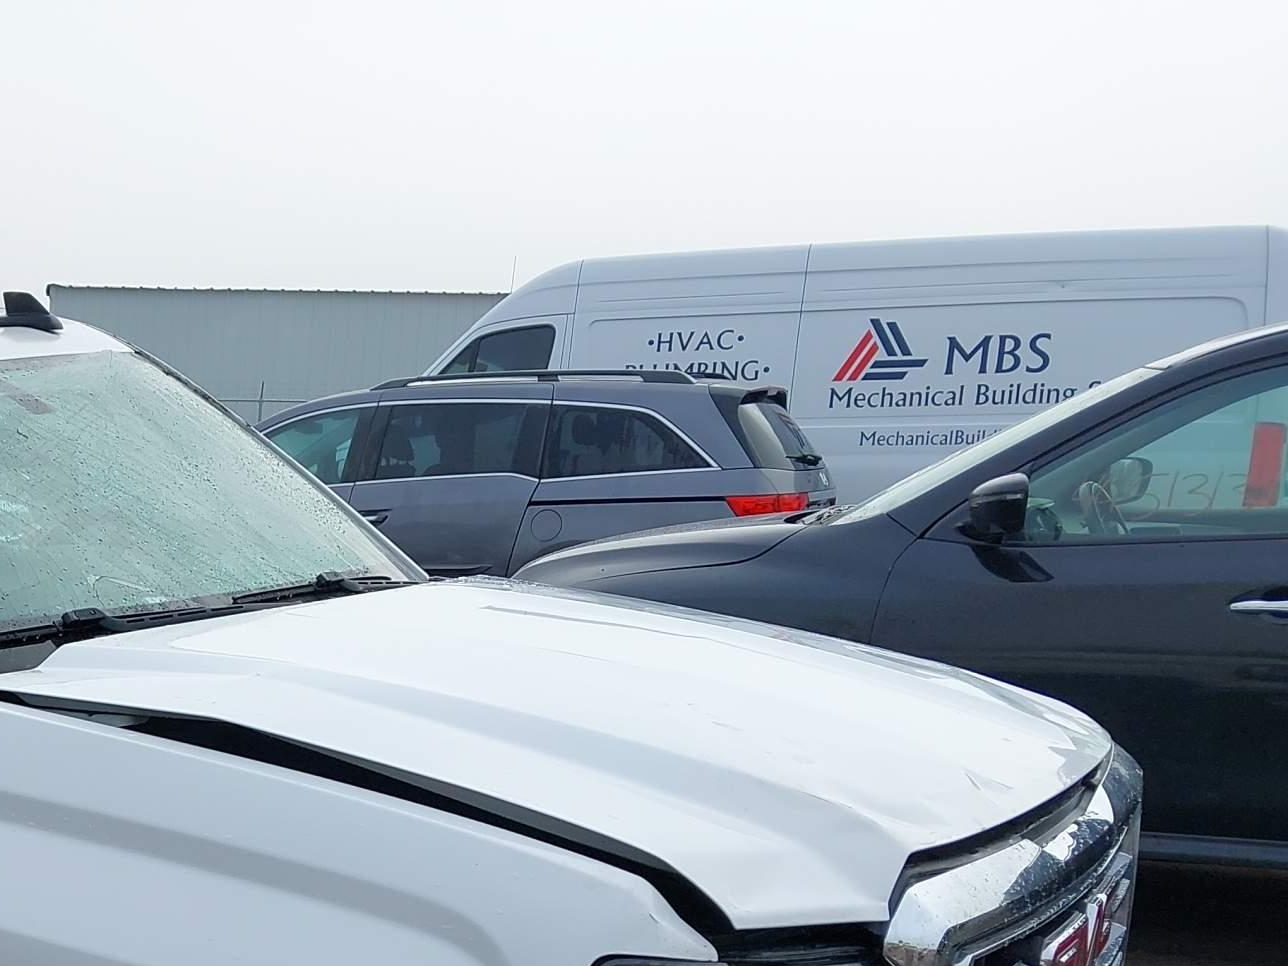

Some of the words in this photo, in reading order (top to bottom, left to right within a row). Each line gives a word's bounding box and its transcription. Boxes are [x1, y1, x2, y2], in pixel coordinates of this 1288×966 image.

[944, 333, 1052, 375] MBS
[828, 385, 964, 408] Mechanical
[975, 382, 1077, 405] Building
